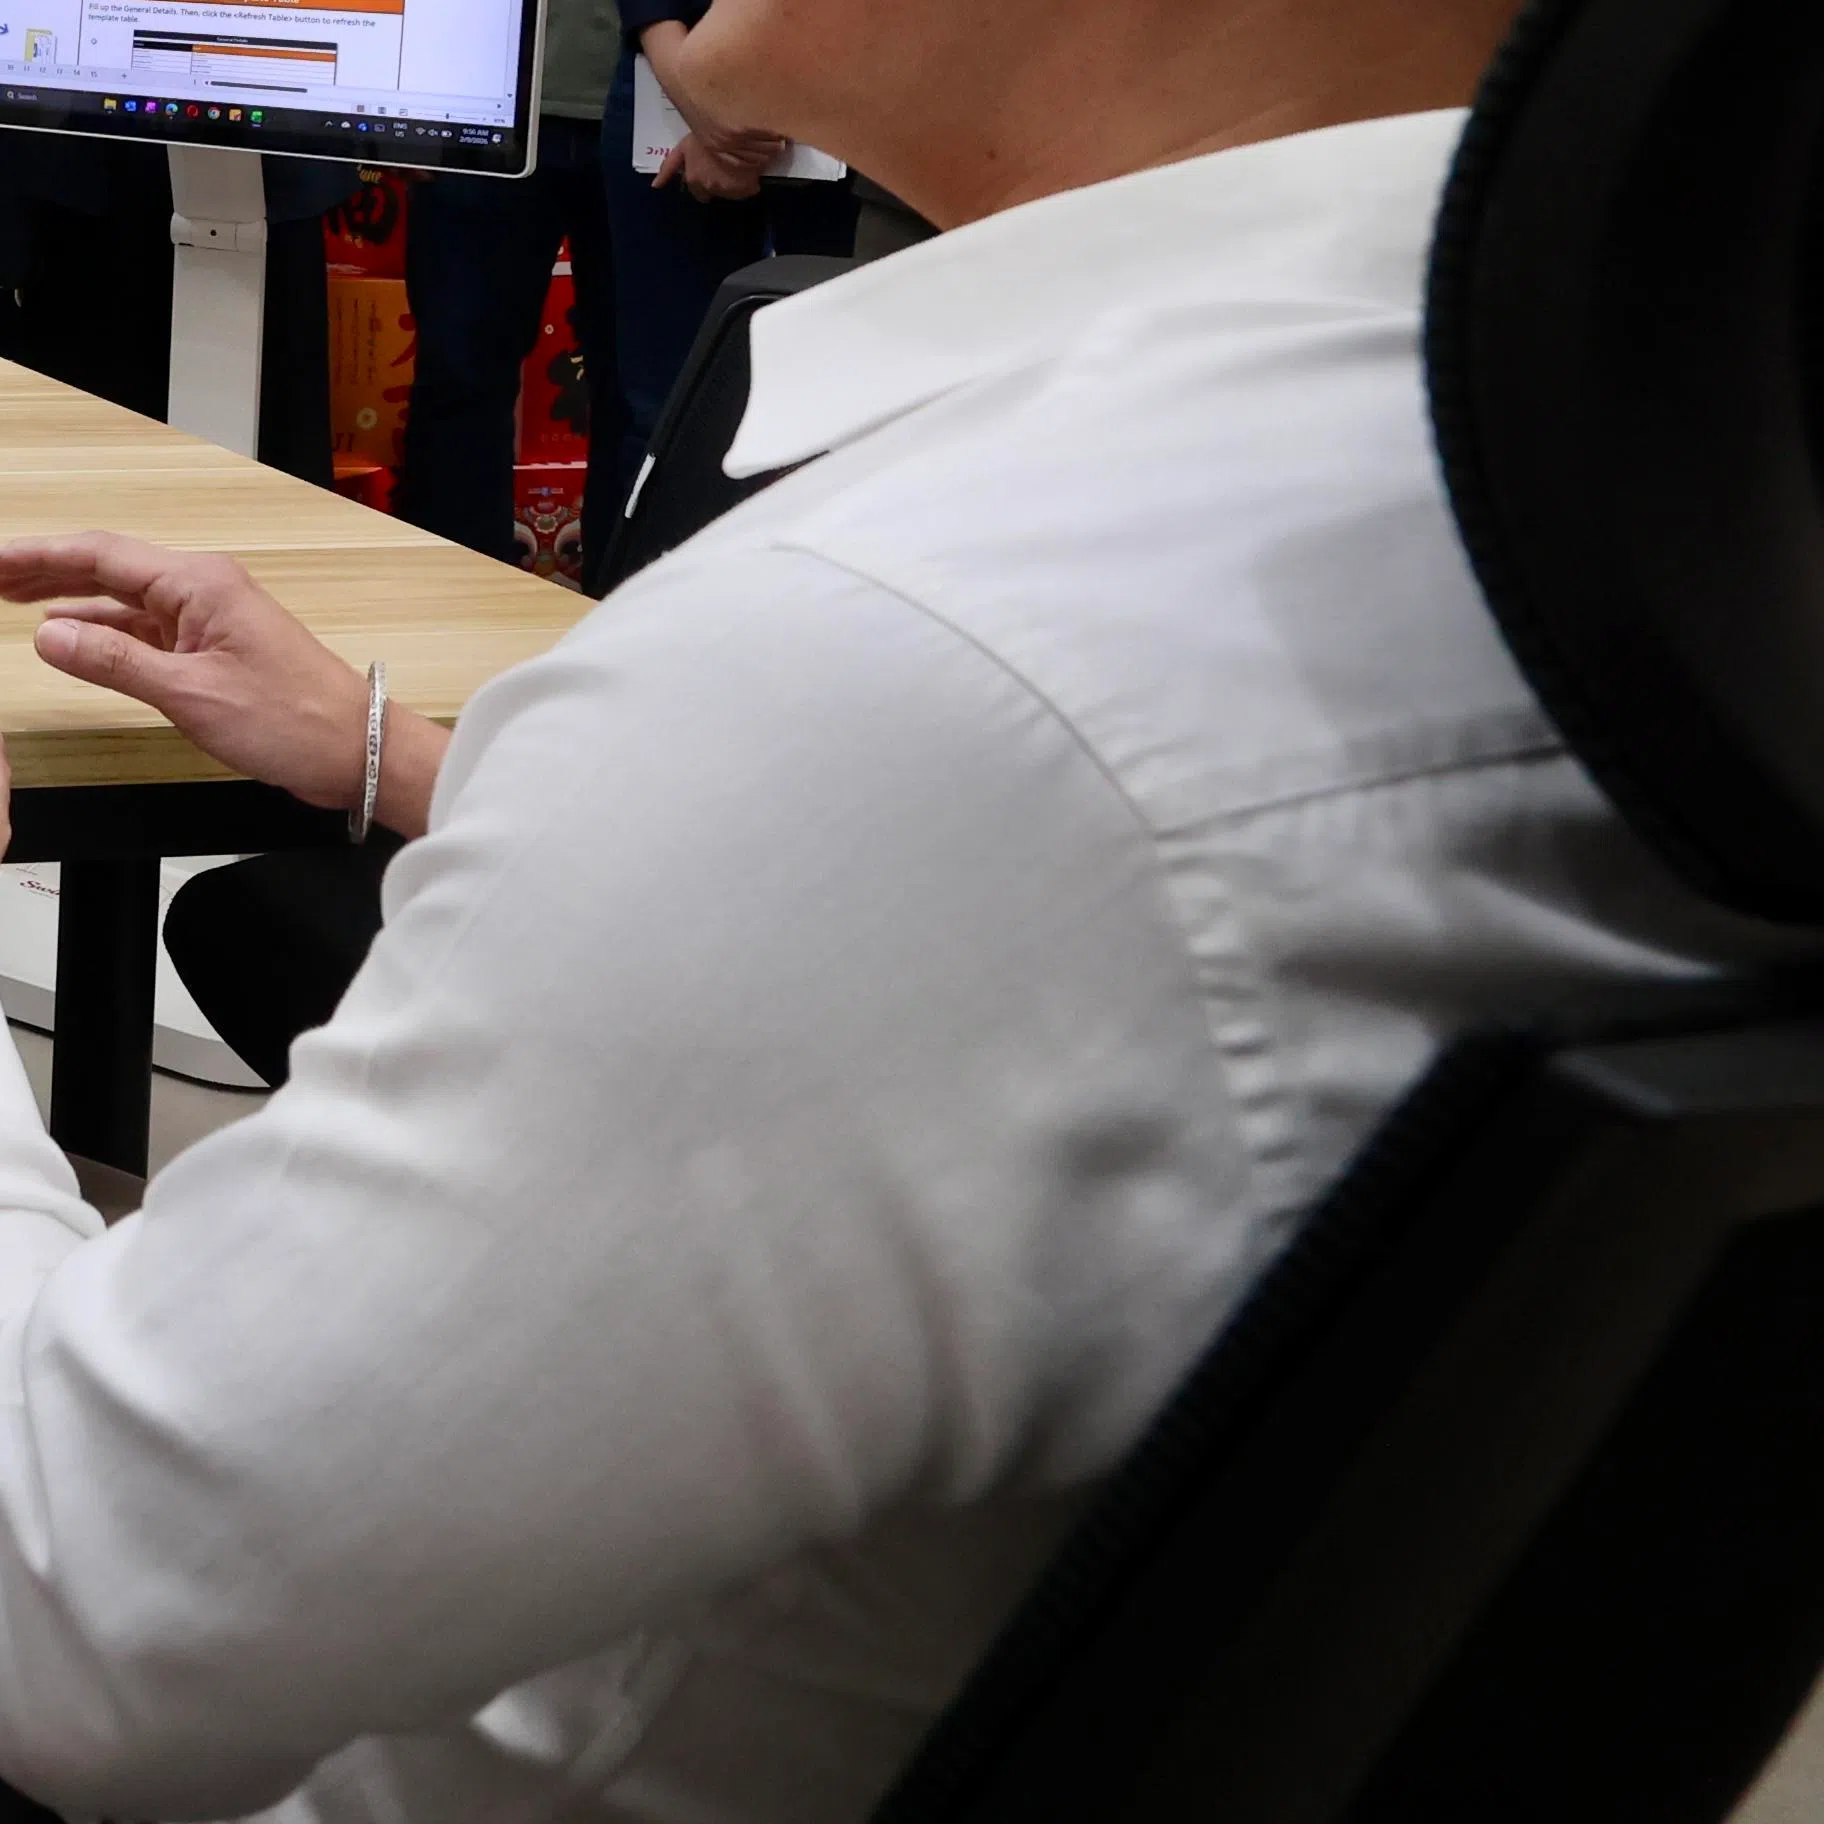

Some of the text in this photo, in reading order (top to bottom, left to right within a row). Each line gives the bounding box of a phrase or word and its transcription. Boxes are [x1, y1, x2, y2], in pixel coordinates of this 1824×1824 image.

[88, 3, 98, 11] Fill
[100, 5, 109, 13] up
[111, 4, 122, 12] the
[124, 4, 151, 14] General
[202, 9, 218, 17] click
[220, 10, 232, 18] the
[233, 11, 266, 21] <Refresh
[268, 13, 293, 22] Table>
[294, 14, 320, 23] button
[322, 16, 330, 24] to
[333, 17, 360, 26] refresh
[88, 13, 121, 23] template
